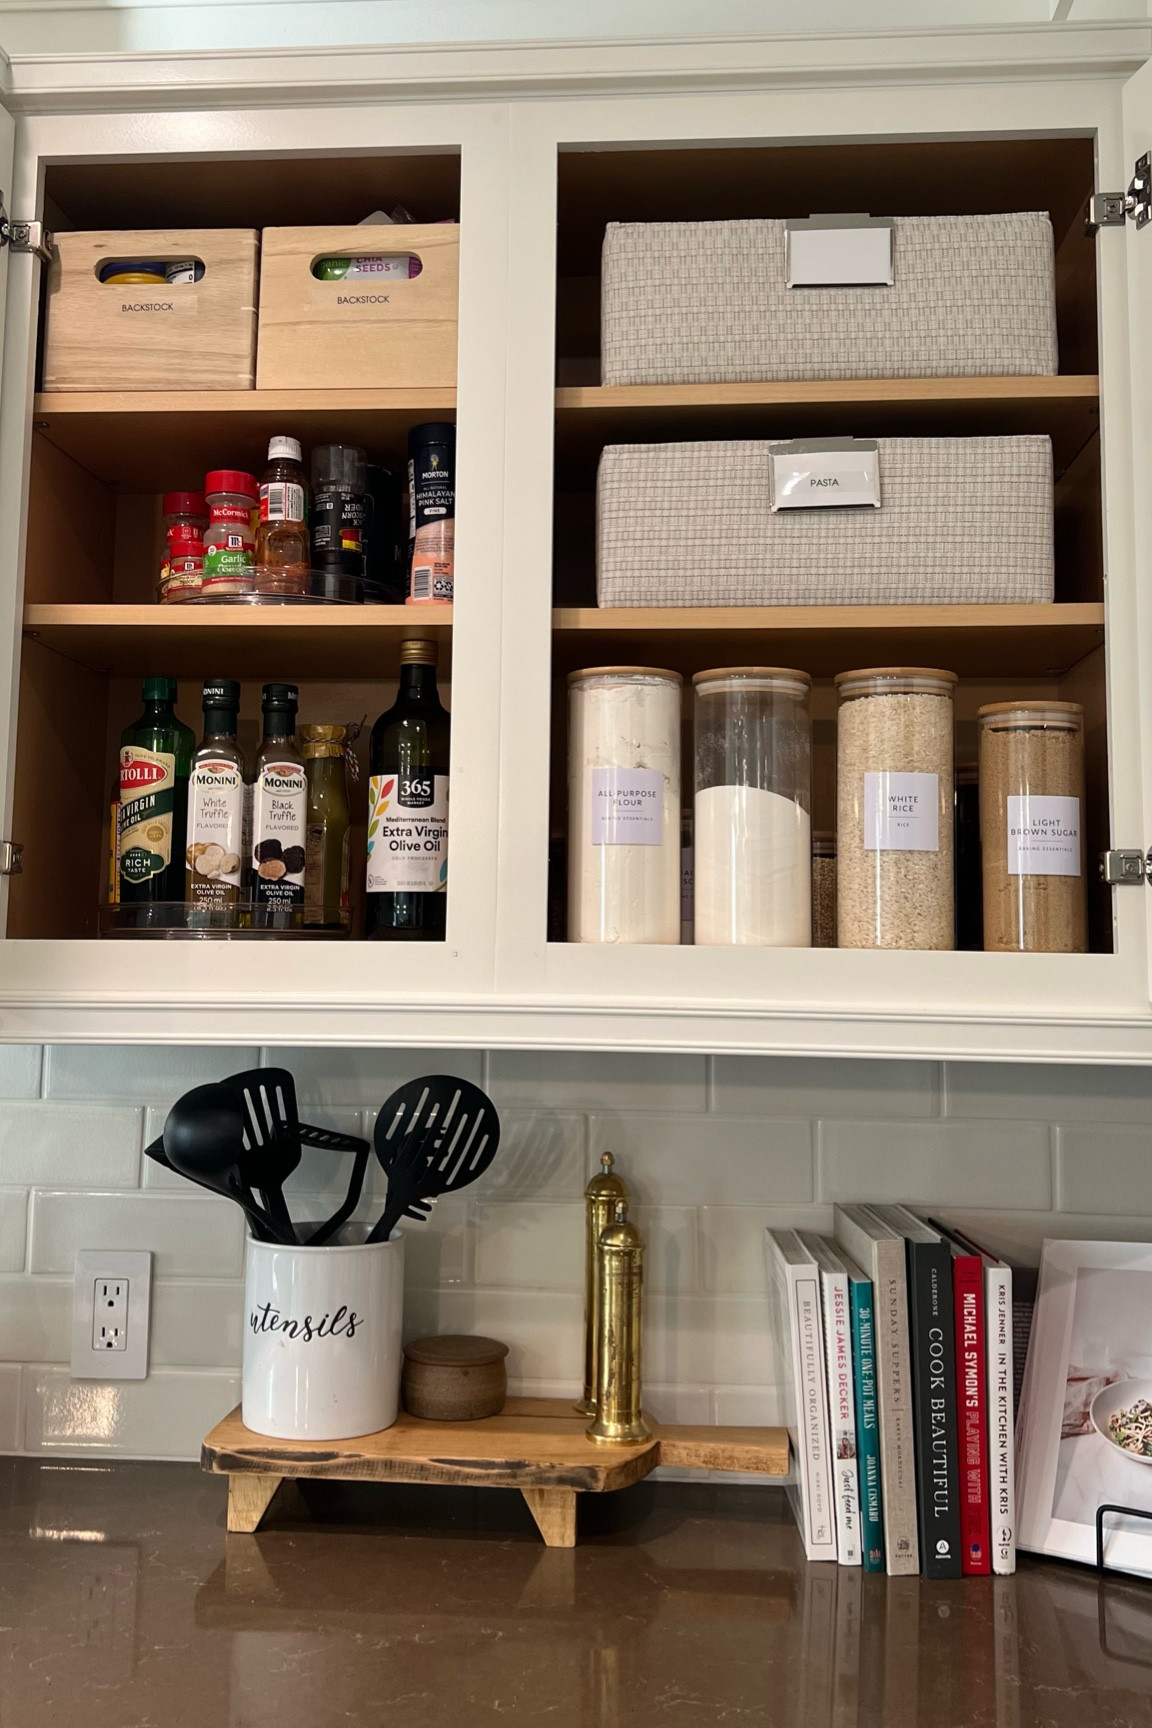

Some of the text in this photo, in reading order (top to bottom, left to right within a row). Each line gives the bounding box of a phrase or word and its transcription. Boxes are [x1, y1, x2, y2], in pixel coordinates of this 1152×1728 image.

[355, 263, 391, 273] SEEDS
[337, 295, 390, 305] BACKSTOCK
[121, 302, 174, 313] BACKSTOCK
[421, 470, 449, 480] MORTON
[810, 478, 840, 487] PASTA
[418, 497, 453, 508] PINK SALT
[213, 508, 249, 519] McCormick
[221, 555, 247, 564] Garlic
[196, 775, 236, 785] MONINI
[264, 777, 303, 789] MONINI
[400, 779, 431, 796] 365
[203, 797, 227, 808] White
[272, 800, 294, 810] Black
[888, 795, 919, 804] WHITE
[126, 794, 156, 817] VIRGIN
[892, 804, 914, 813] RICE
[201, 808, 228, 819] Truffle
[269, 810, 297, 821] Truffle
[130, 815, 141, 824] OIL
[1032, 819, 1061, 827] LIGHT
[383, 826, 448, 840] Extra Virgin
[1010, 828, 1078, 838] BROWN SUGAR
[389, 840, 440, 852] Olive Oil
[125, 859, 151, 867] RICH
[998, 1284, 1006, 1345] KRIS JENNER
[250, 1302, 364, 1342] utensils
[888, 1279, 901, 1403] SUNDAY SUPPERS
[834, 1286, 849, 1420] JESSIE JAMES DECKER
[963, 1293, 979, 1407] MICHAEL SYMON'S
[859, 1307, 876, 1429] 30-MINUTE ONE-POT MEALS
[803, 1300, 820, 1461] BEAUTIFULLY ORGANIZED
[929, 1328, 949, 1518] COOK BEAUTIFUL
[966, 1411, 981, 1465] PLAYING
[998, 1353, 1009, 1515] IN THE KITCHEN WITH KRIS
[866, 1454, 879, 1522] JOANNA CISMARU
[966, 1469, 982, 1503] WITH
[841, 1470, 856, 1530] Just feed me
